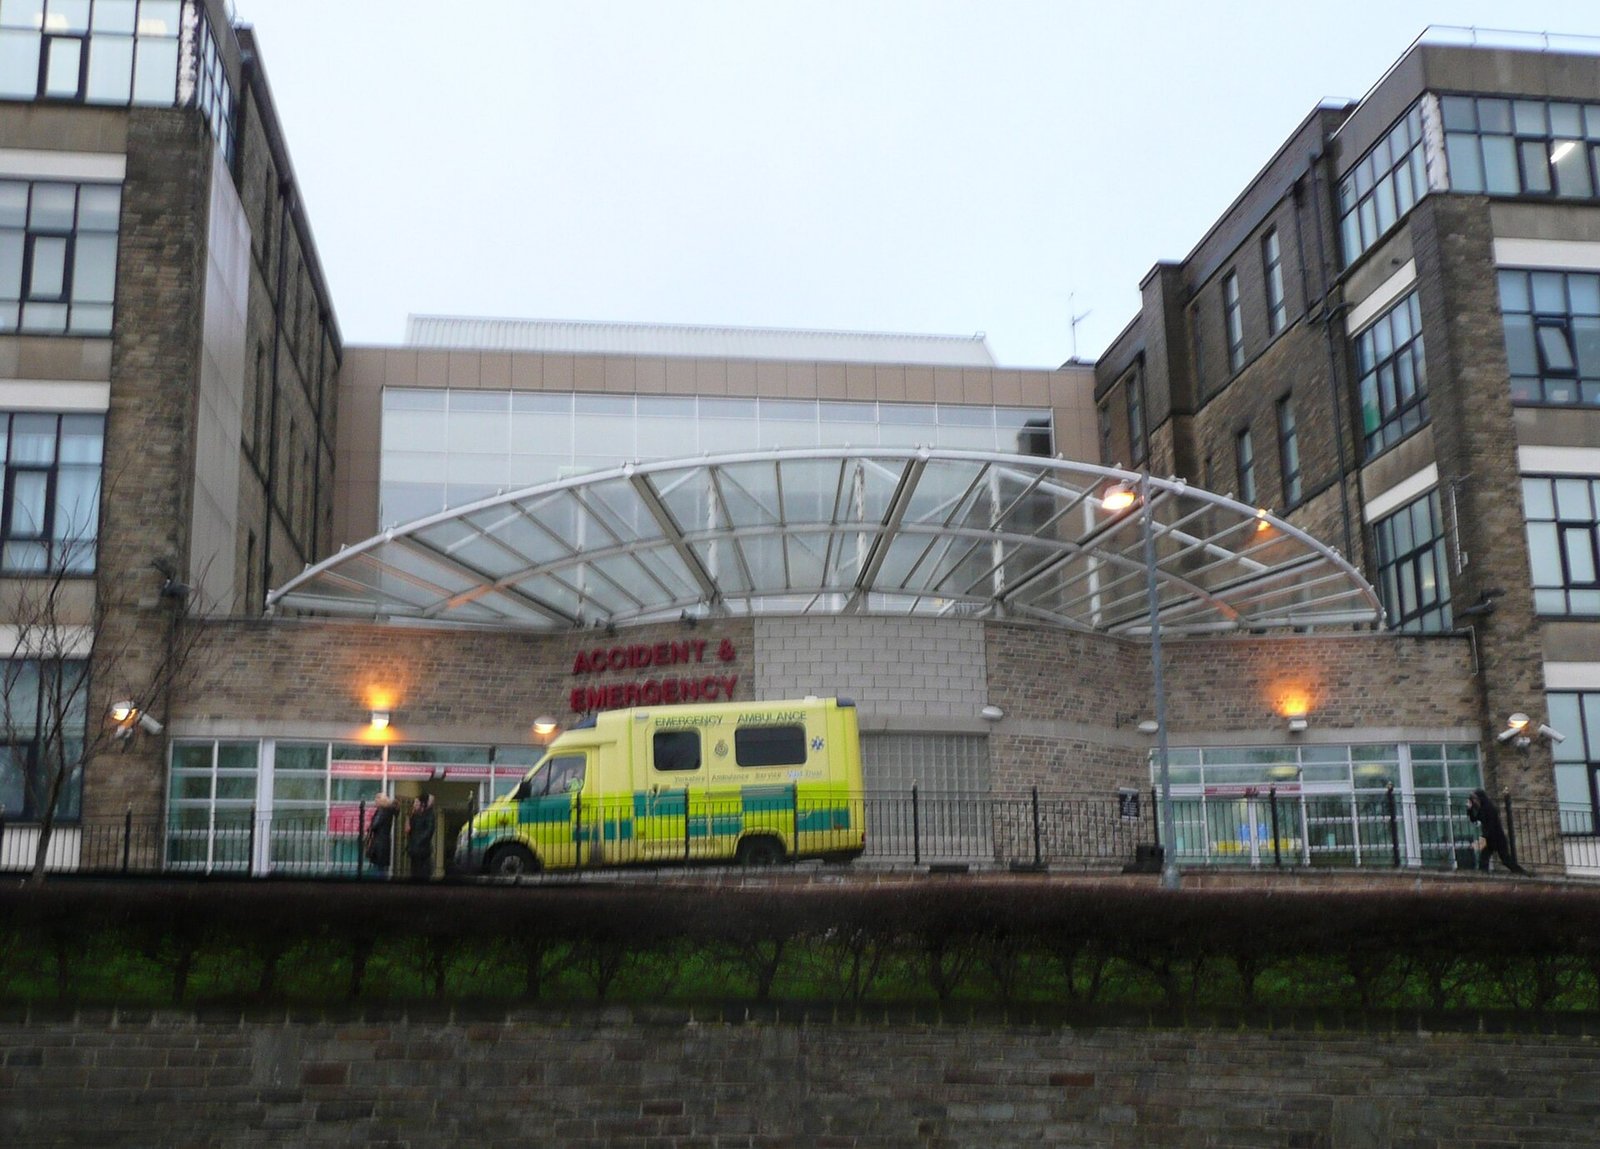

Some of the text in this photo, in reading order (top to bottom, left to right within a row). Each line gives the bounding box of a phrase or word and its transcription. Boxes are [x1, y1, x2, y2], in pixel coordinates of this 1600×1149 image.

[572, 638, 736, 675] ACCIDENT &
[569, 674, 738, 713] EMERGENCY
[655, 711, 807, 727] EMERGENCY AMBULANCE
[711, 771, 750, 781] Ambulance
